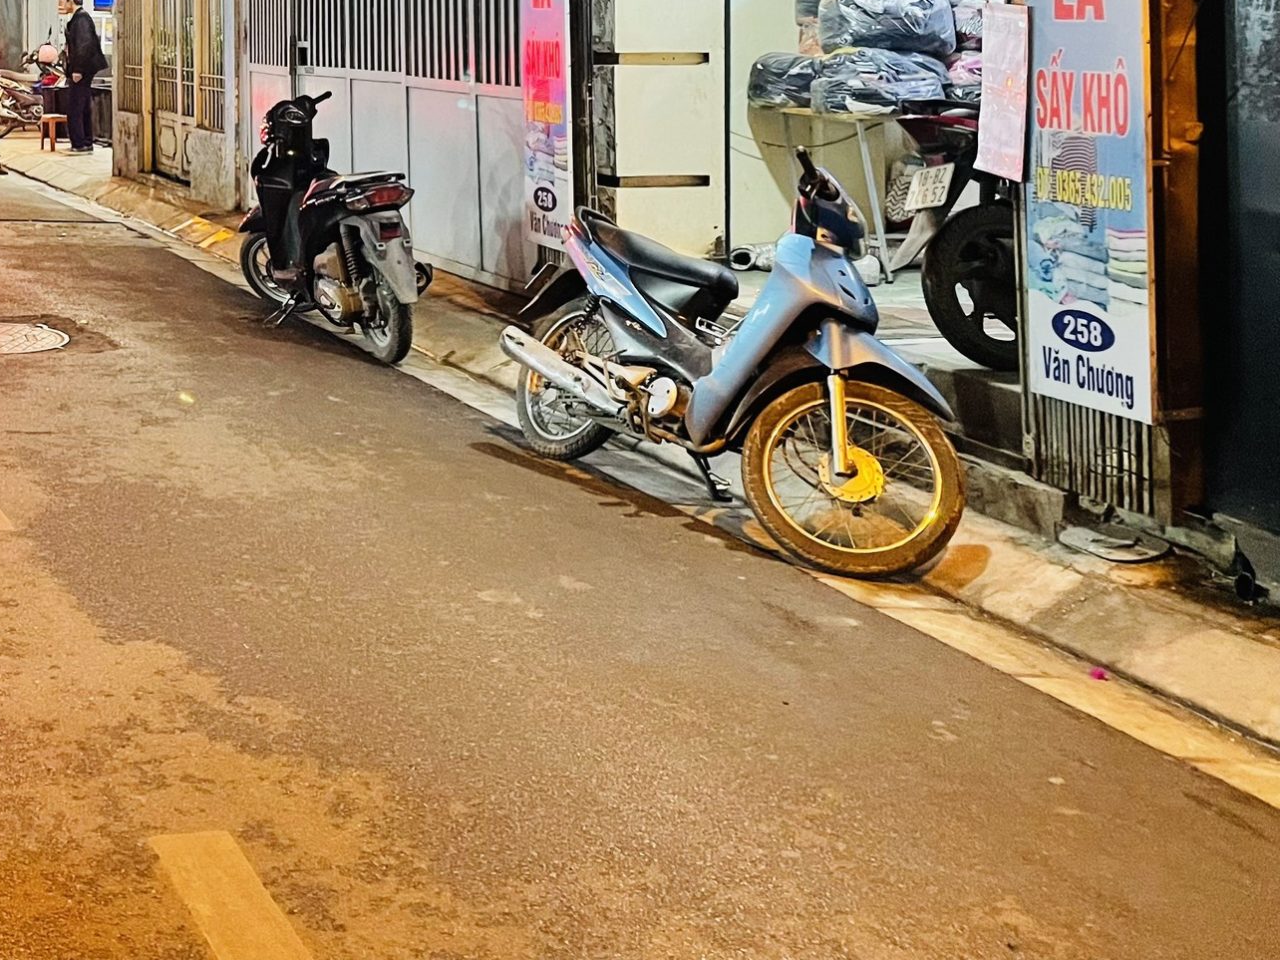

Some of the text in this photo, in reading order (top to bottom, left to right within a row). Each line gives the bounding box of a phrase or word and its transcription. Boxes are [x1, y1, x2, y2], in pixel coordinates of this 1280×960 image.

[1036, 48, 1130, 136] SẤY KHÔ
[537, 190, 553, 209] 258
[1063, 314, 1103, 347] 258
[1042, 345, 1134, 410] Văn Chương
